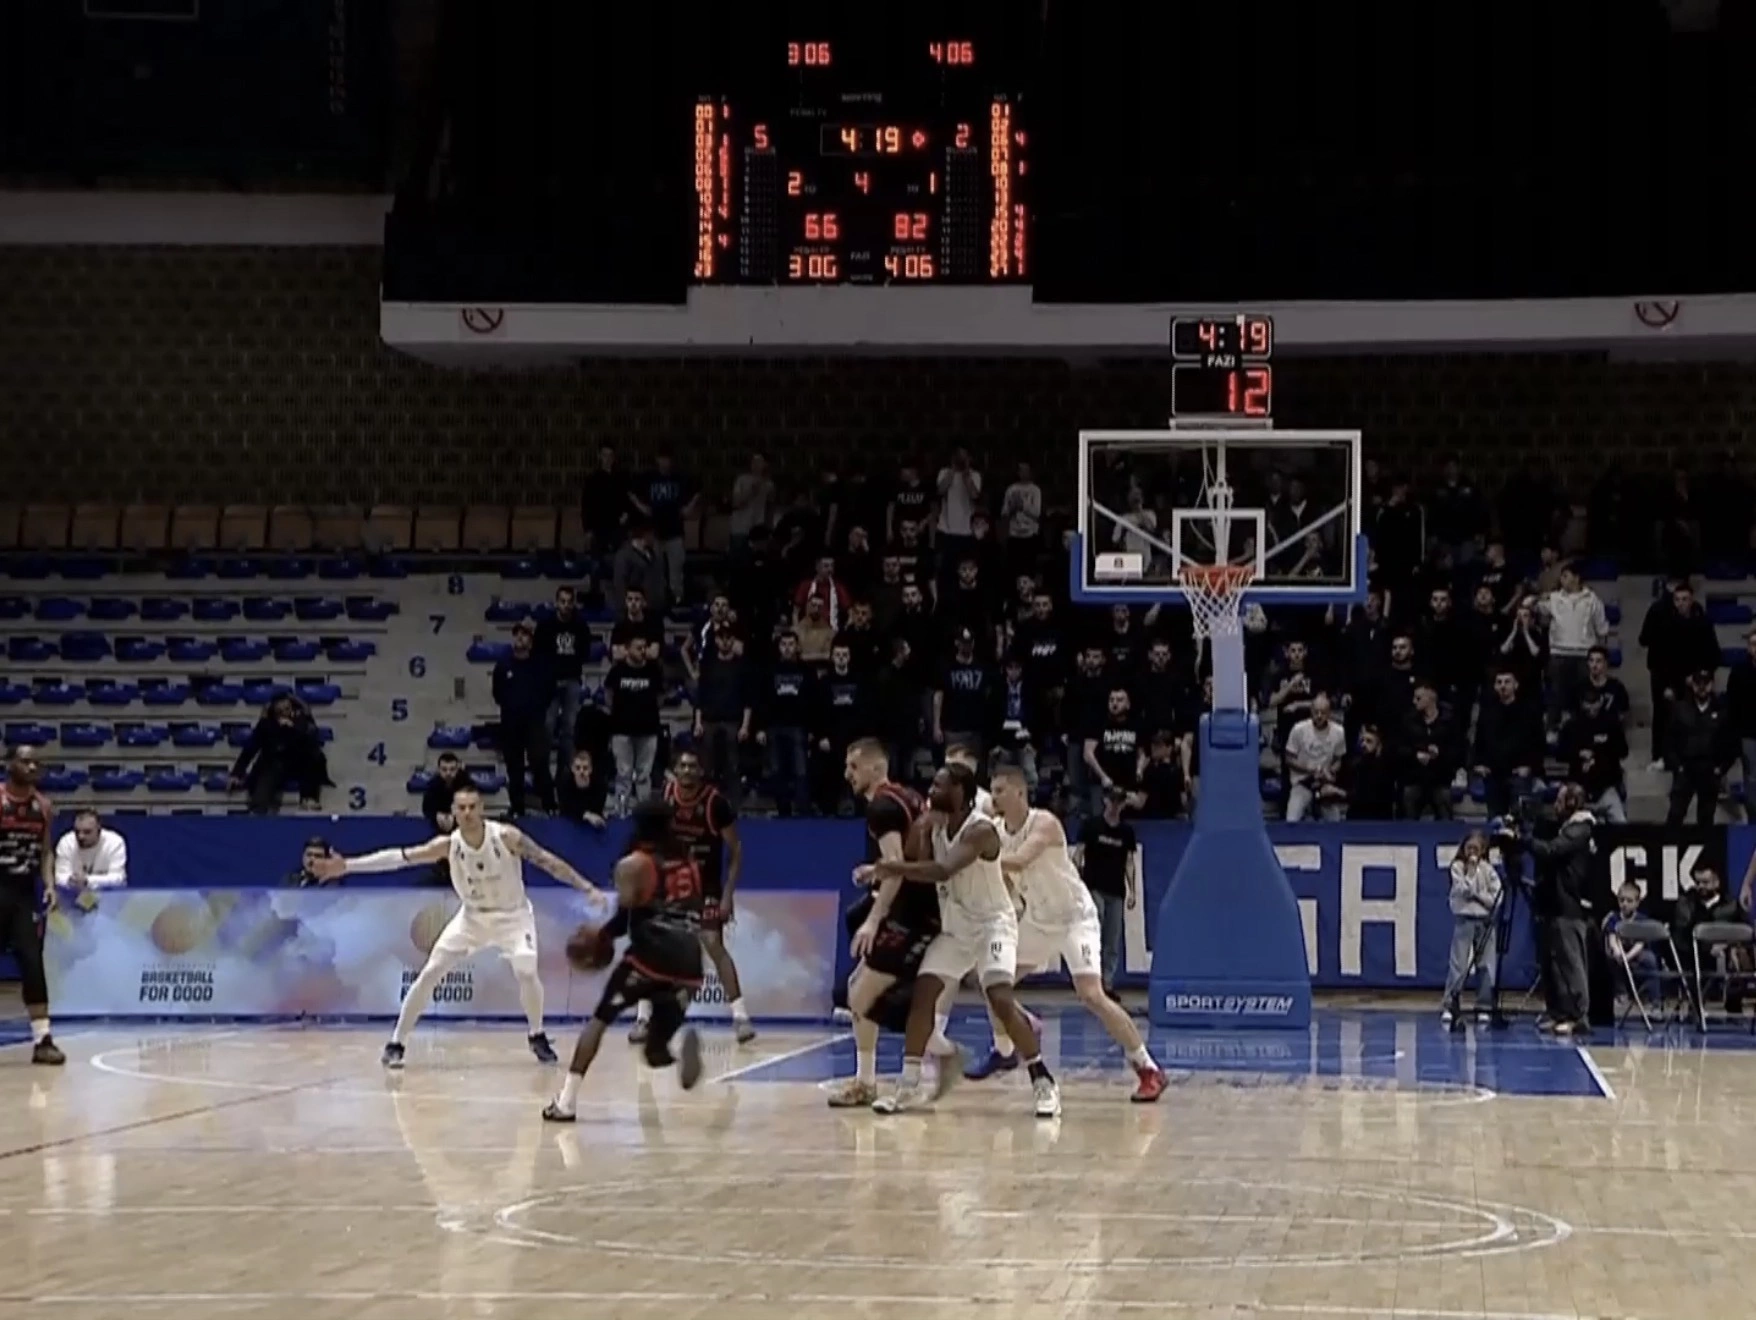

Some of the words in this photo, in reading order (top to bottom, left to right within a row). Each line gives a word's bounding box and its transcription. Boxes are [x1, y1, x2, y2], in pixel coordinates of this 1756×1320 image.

[787, 172, 801, 195] 2
[855, 171, 868, 194] 4
[805, 214, 838, 239] 66
[895, 214, 927, 239] 82
[1199, 321, 1266, 352] 4:19
[1207, 354, 1235, 367] FAZI
[1228, 370, 1268, 415] 12
[429, 615, 446, 635] 7
[409, 655, 426, 678] 6
[391, 699, 408, 721] 5
[367, 742, 387, 767] 4
[349, 786, 367, 811] 3
[141, 971, 214, 984] BASKETBALL
[139, 985, 169, 1002] FOR
[172, 985, 213, 1002] GOOD
[433, 985, 473, 1002] GOOD
